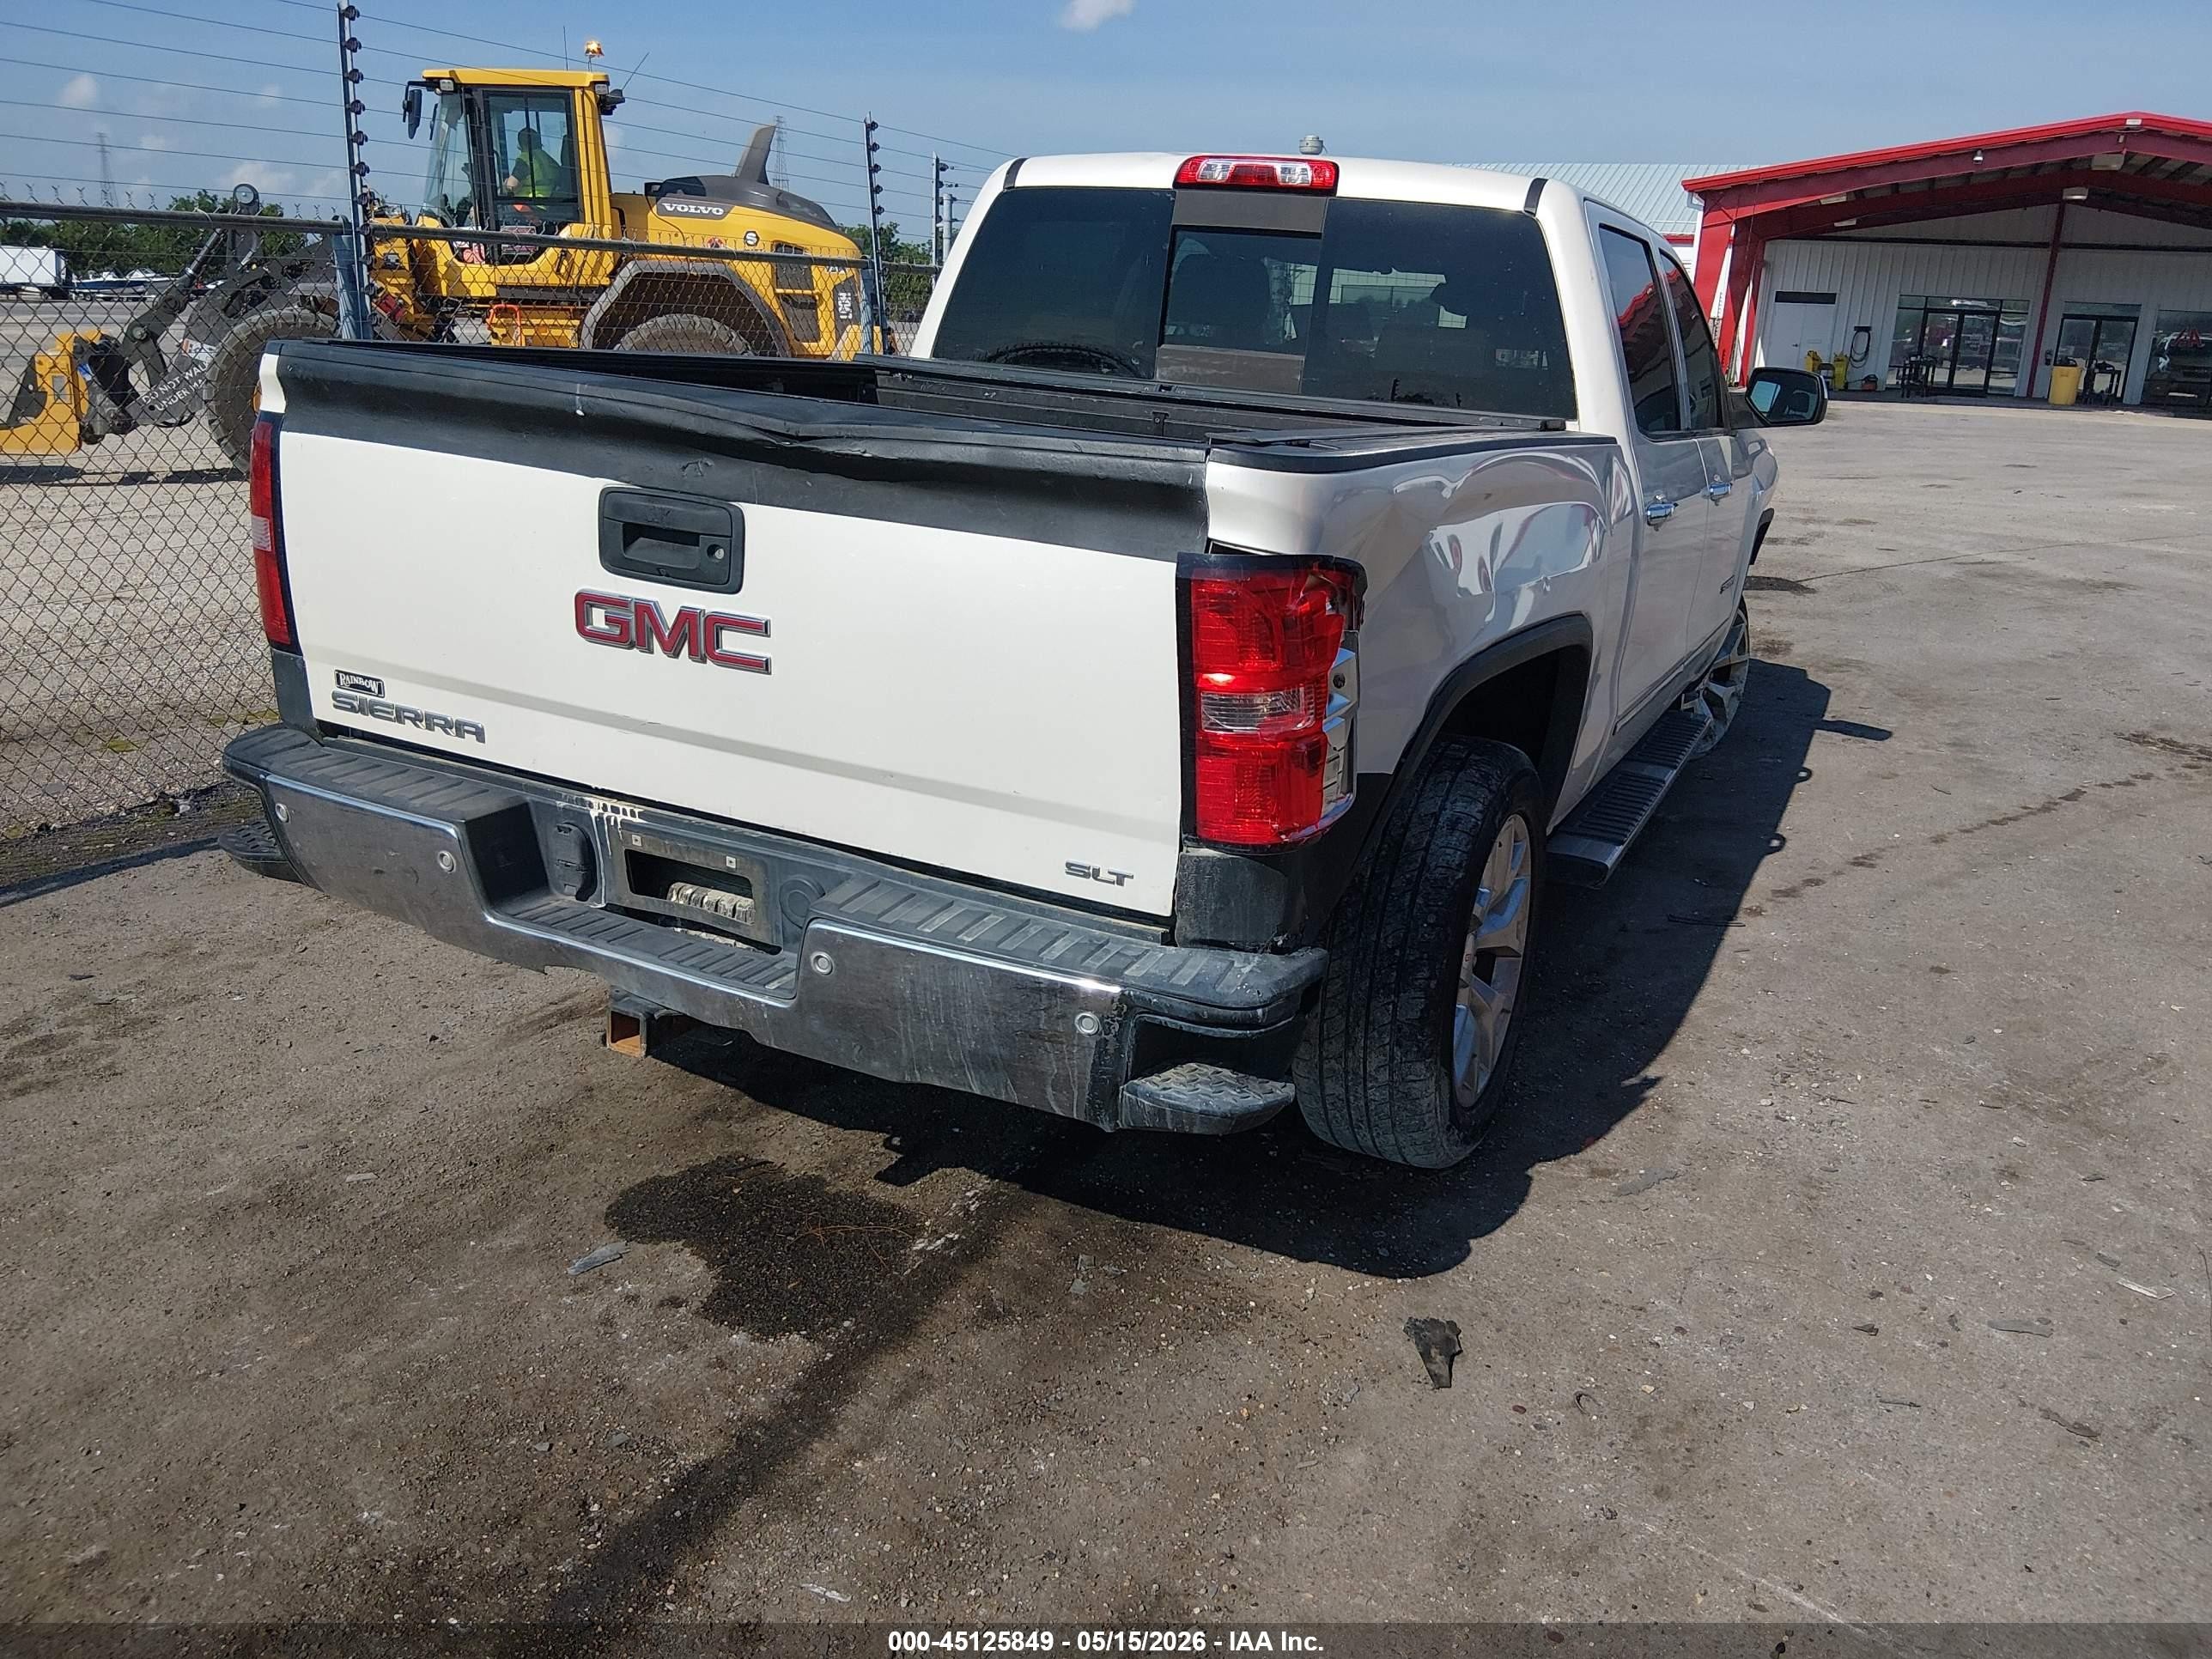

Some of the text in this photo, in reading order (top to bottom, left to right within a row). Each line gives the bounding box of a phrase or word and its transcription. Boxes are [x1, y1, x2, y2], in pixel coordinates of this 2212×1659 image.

[661, 203, 725, 216] VOLVO
[141, 391, 160, 405] DO
[158, 376, 182, 395] NOT
[155, 387, 191, 411] UNDER
[574, 587, 773, 676] GMC
[329, 690, 487, 744] SIERRA
[1065, 860, 1134, 887] SLT
